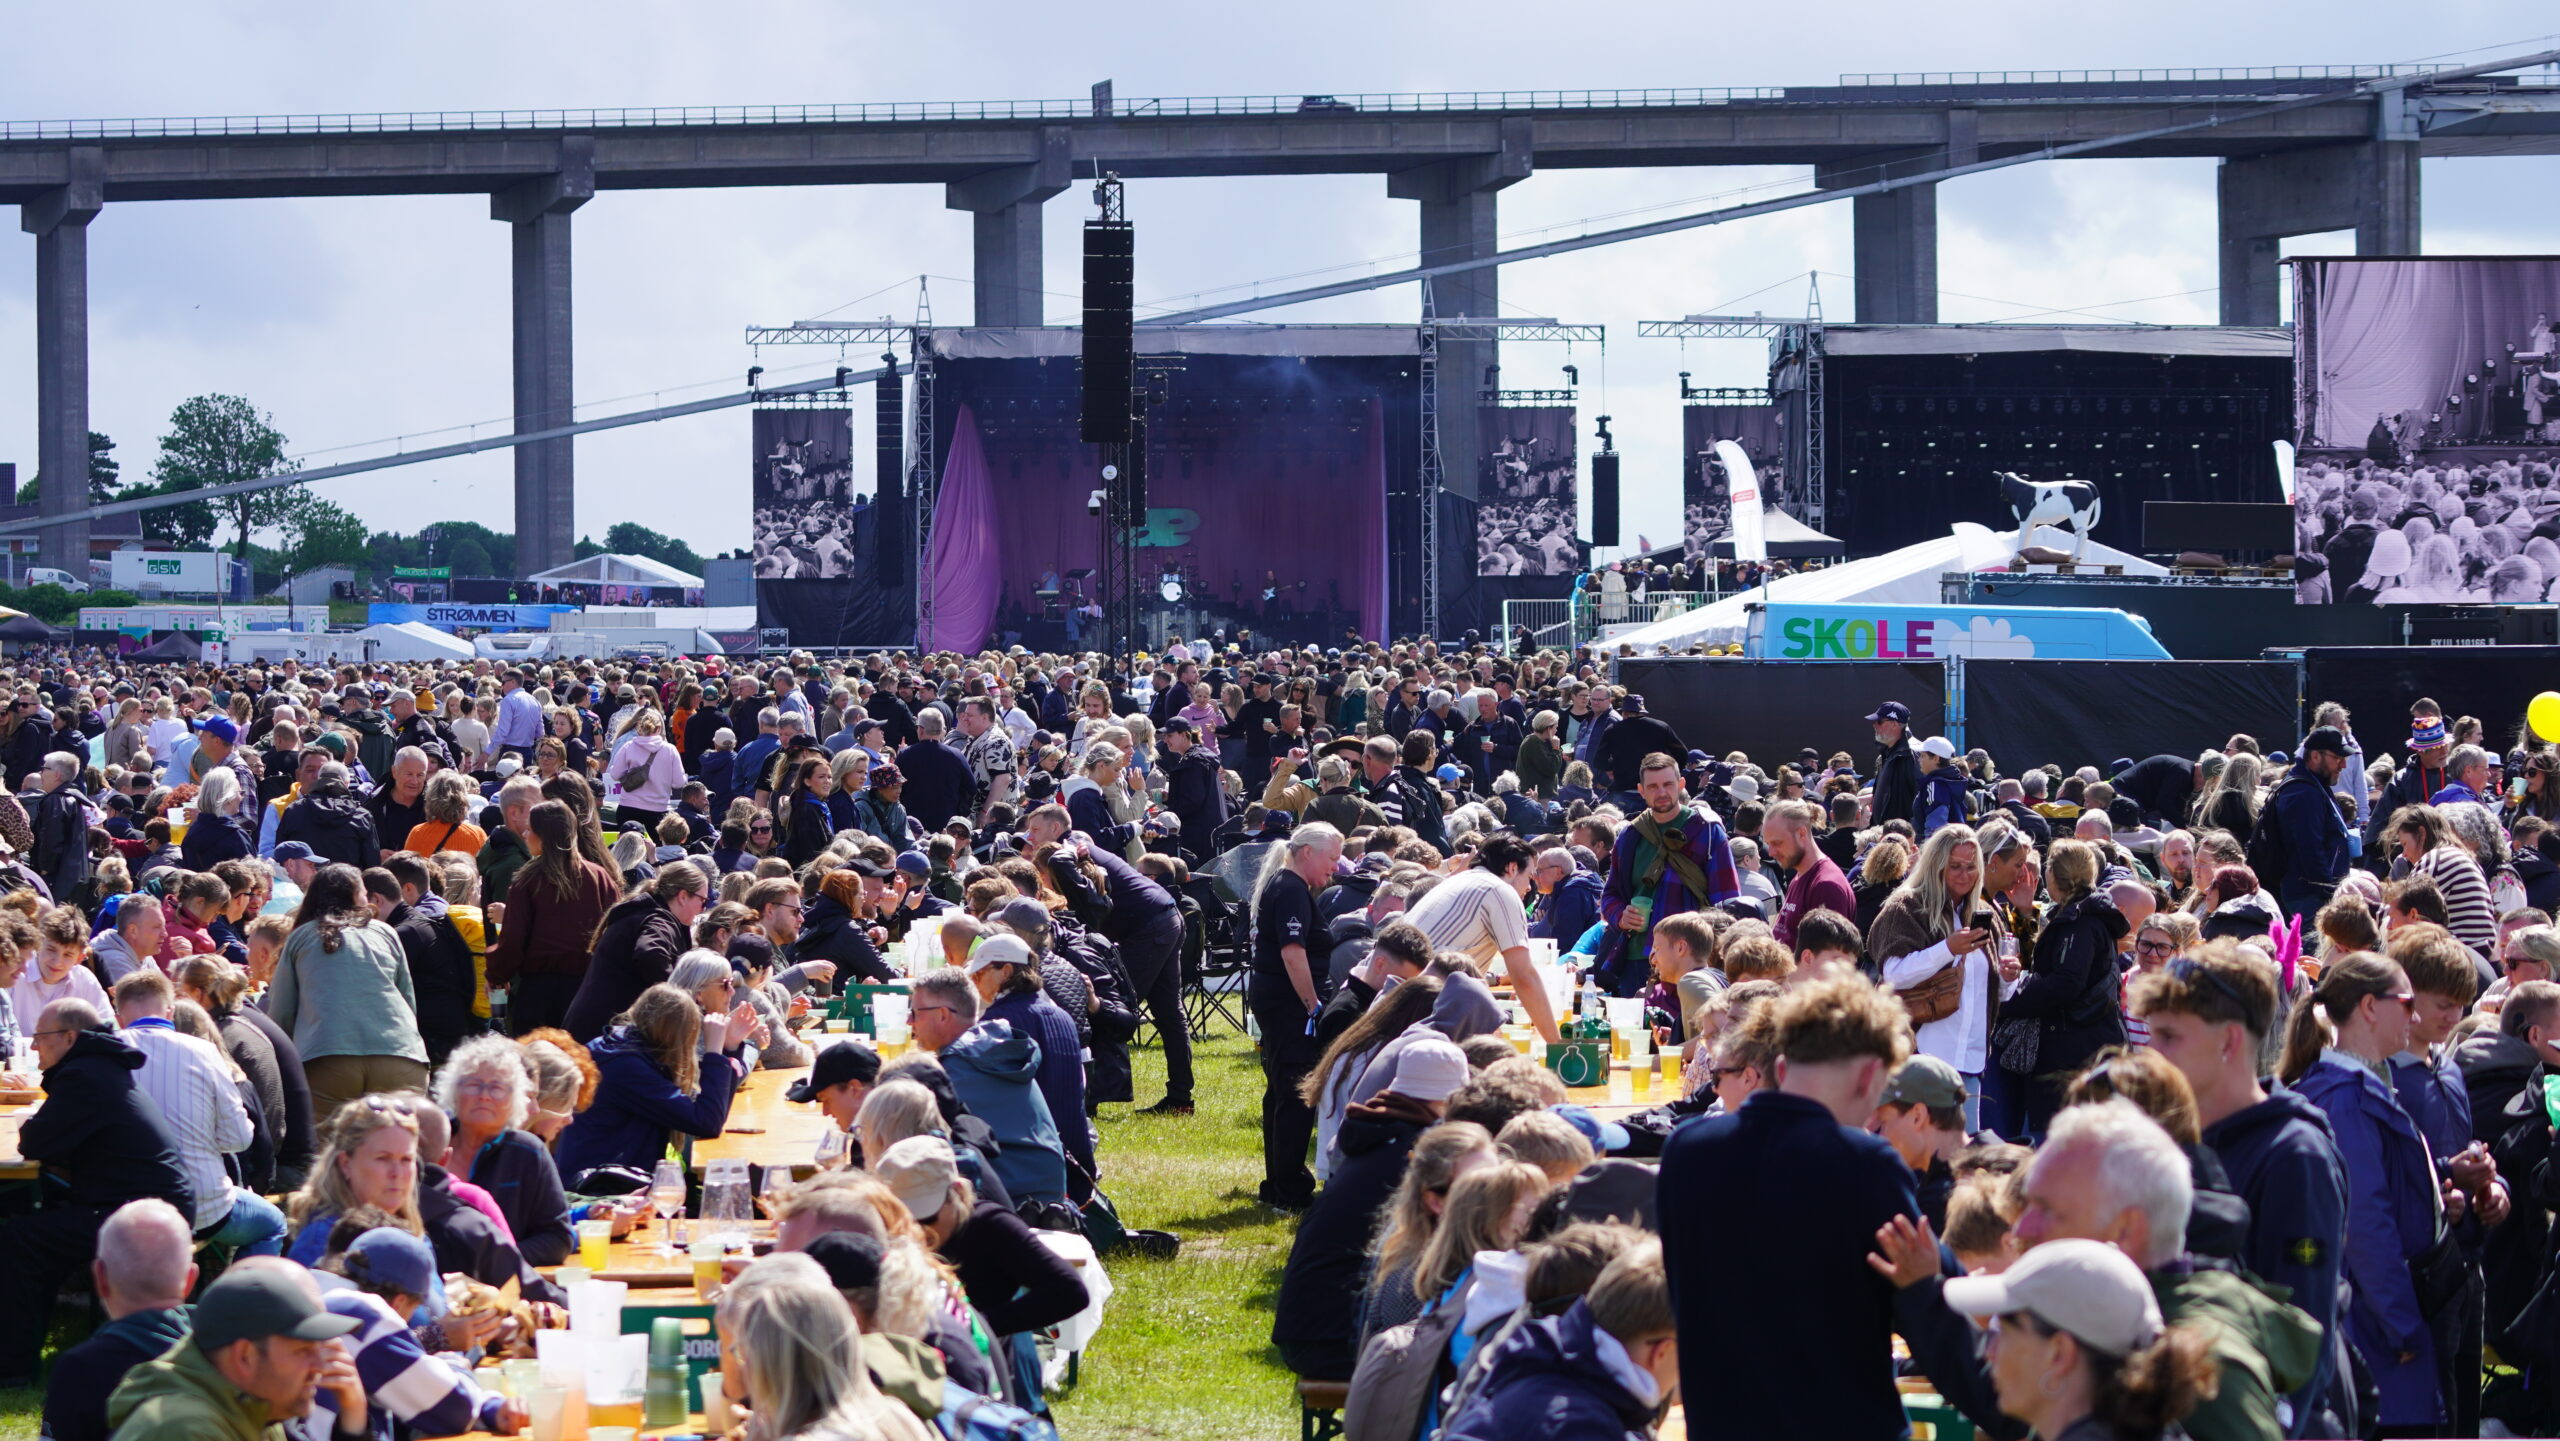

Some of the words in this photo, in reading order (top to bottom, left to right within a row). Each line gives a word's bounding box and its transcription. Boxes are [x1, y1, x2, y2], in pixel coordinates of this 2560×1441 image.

[148, 564, 180, 574] GSV
[427, 608, 515, 623] STRØMMEN
[1782, 618, 1934, 658] SKOLE
